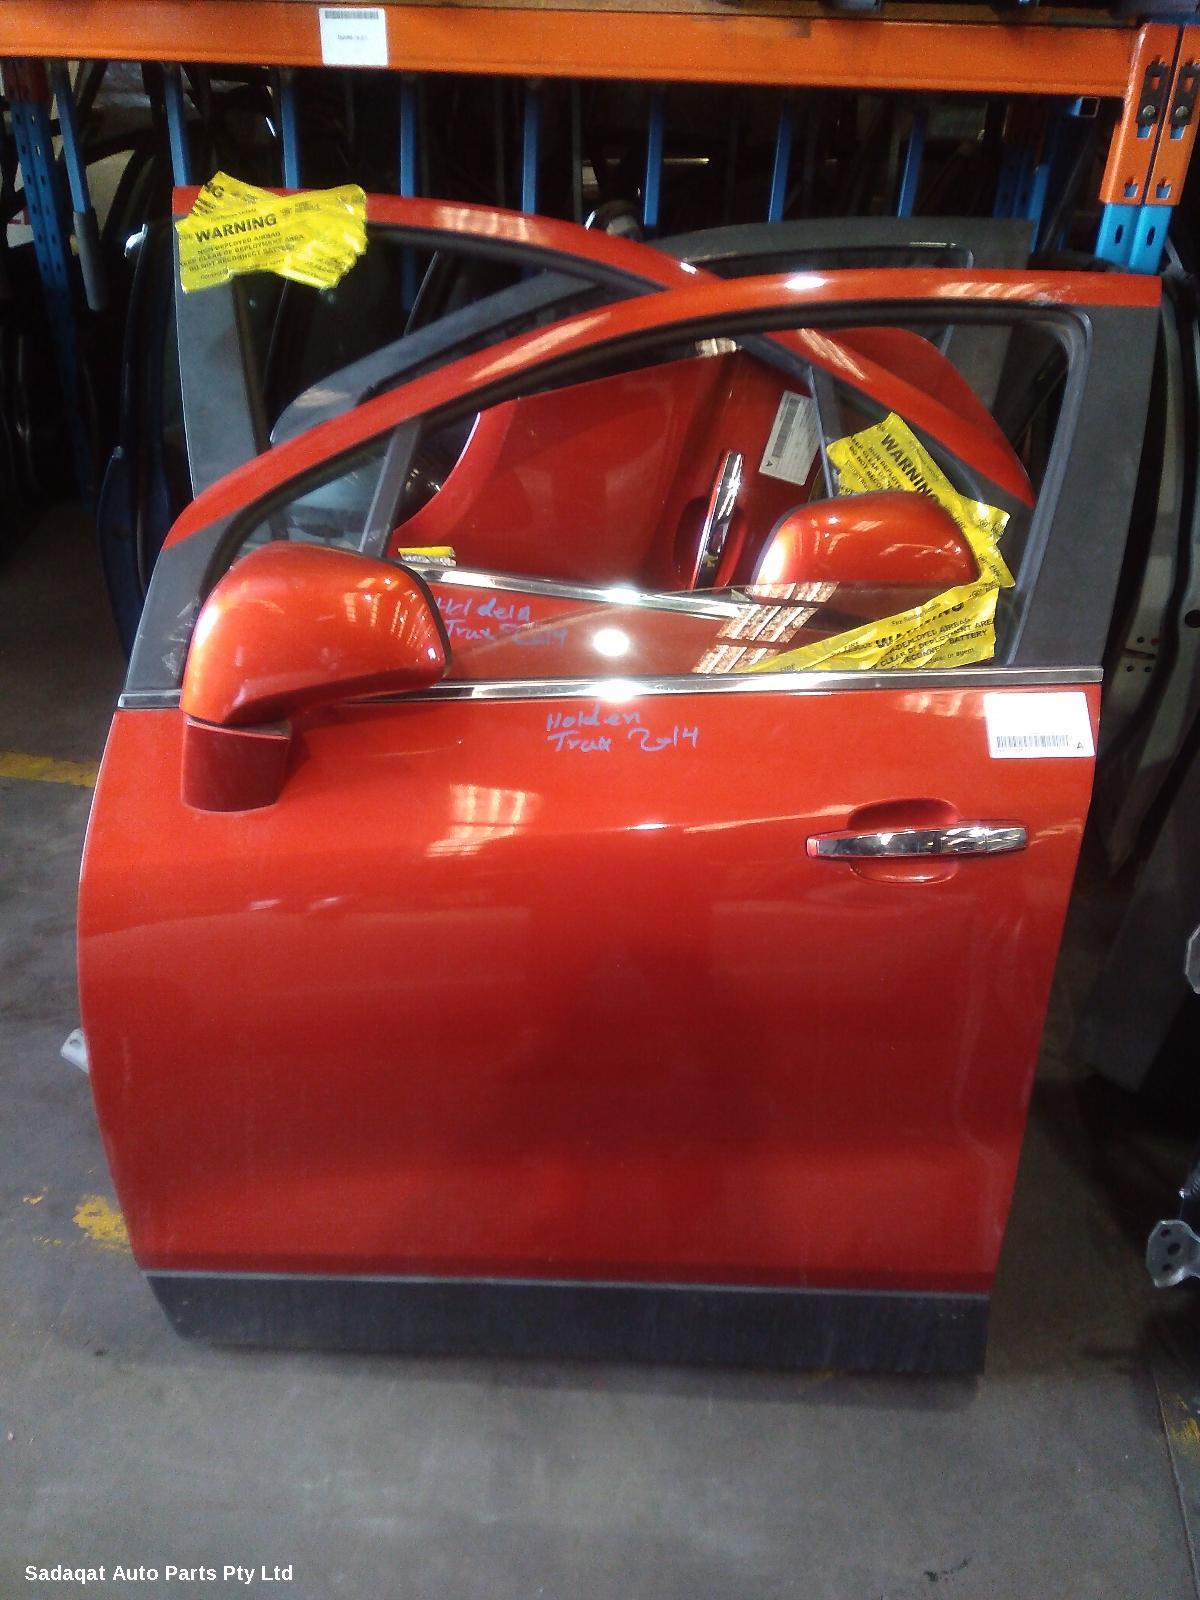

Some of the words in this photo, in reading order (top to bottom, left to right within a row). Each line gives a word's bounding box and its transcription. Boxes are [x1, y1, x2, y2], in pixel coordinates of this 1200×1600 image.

[195, 213, 277, 243] WARNING
[949, 629, 988, 645] BATTERY
[546, 704, 641, 732] Holden
